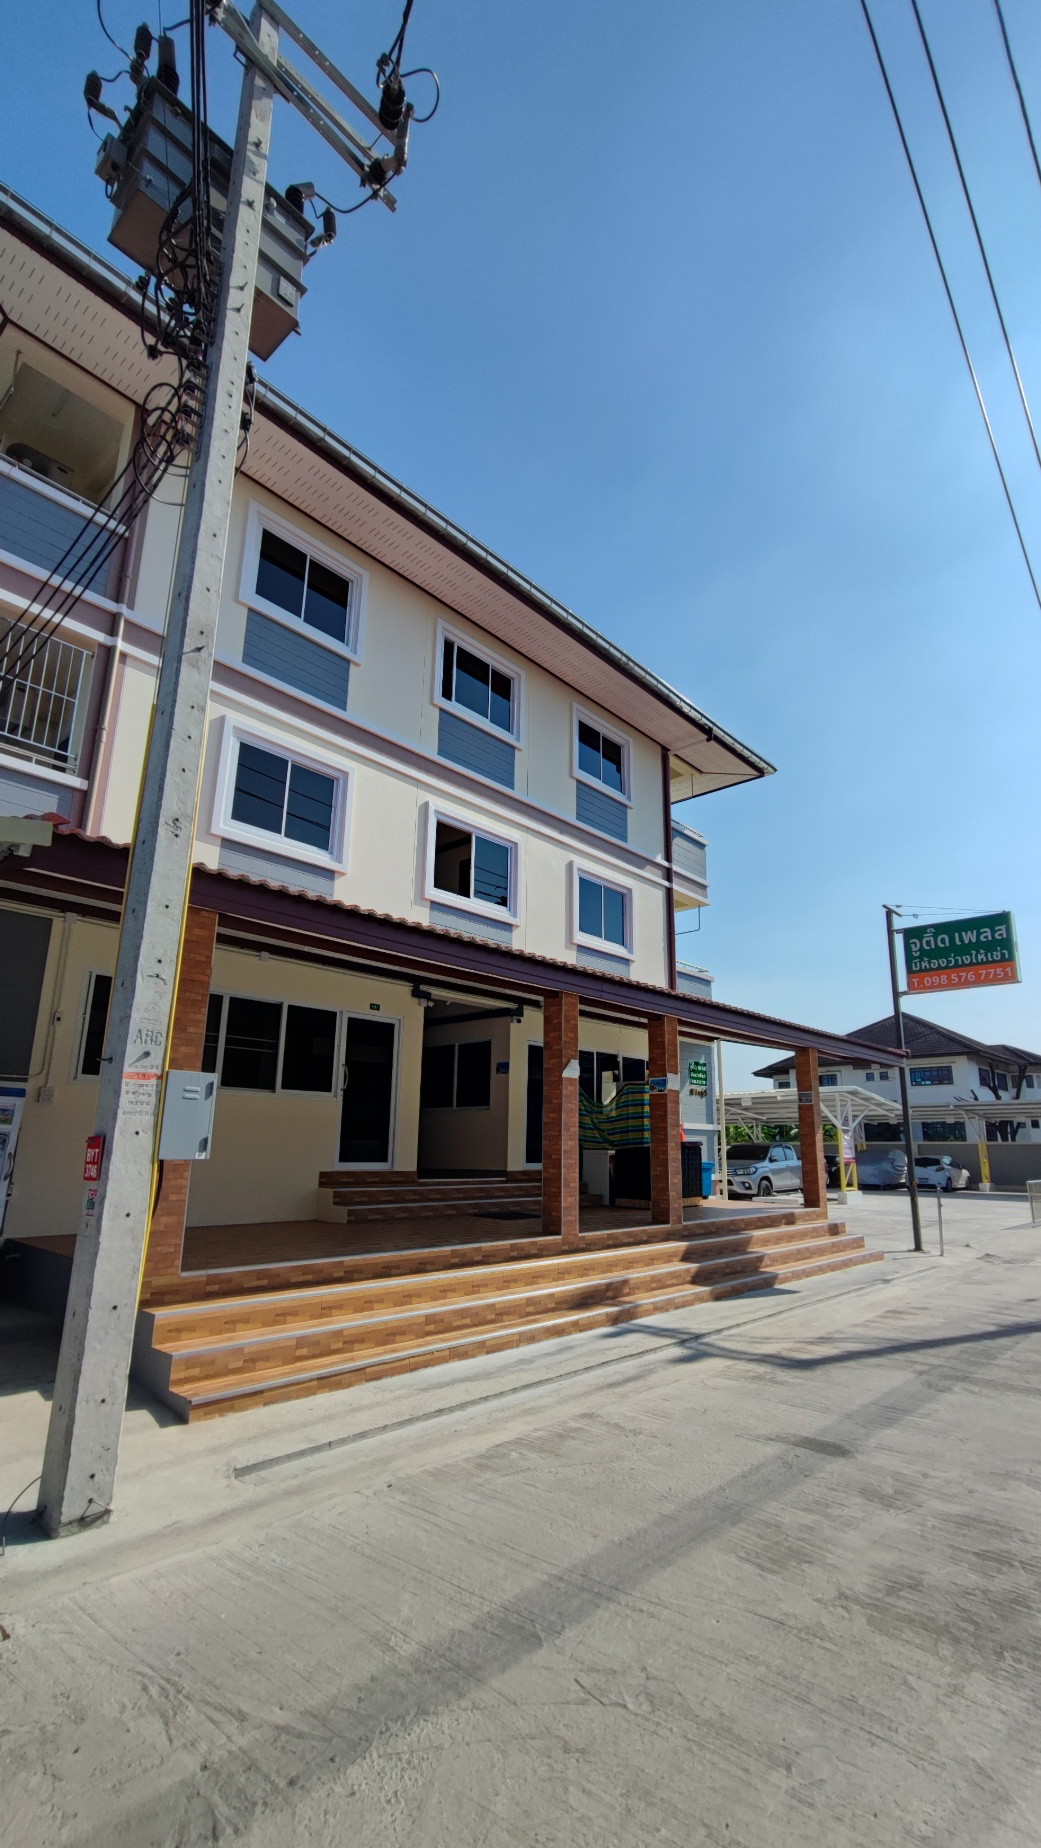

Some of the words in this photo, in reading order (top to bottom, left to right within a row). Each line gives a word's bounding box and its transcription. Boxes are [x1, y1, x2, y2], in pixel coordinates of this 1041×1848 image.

[955, 925, 1007, 945] เพลส
[951, 972, 976, 983] 576
[979, 967, 1012, 980] 7751
[86, 1148, 99, 1162] BYT
[84, 1164, 98, 1178] 3746
